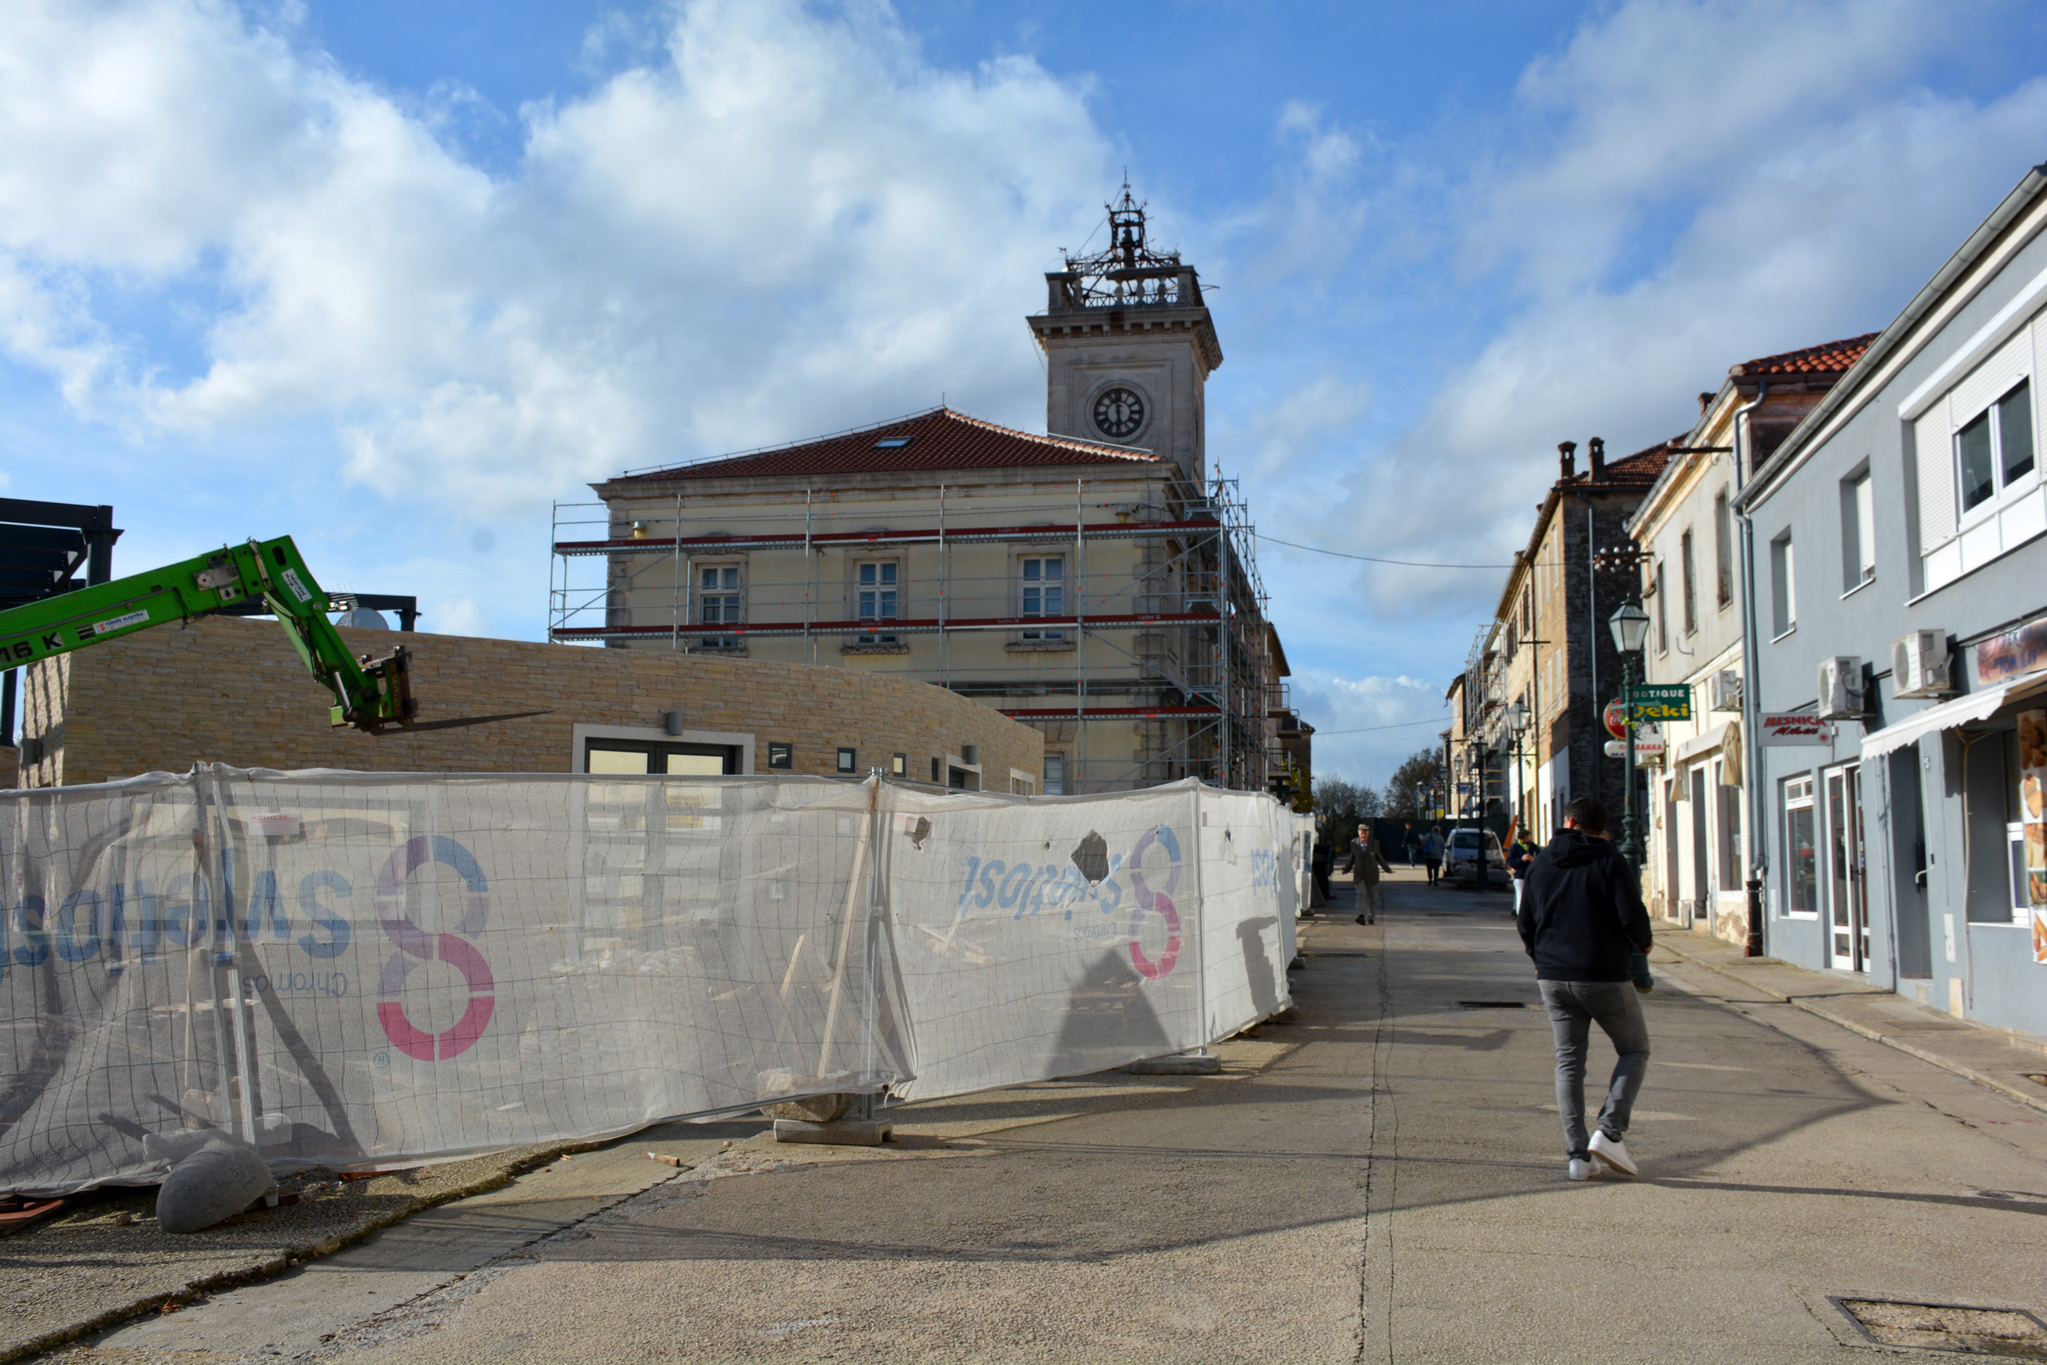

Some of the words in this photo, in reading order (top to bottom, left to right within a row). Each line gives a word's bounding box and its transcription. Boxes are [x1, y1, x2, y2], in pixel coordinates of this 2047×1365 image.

[42, 631, 64, 650] K
[1764, 715, 1827, 728] MESNICA
[243, 972, 348, 997] Chromos
